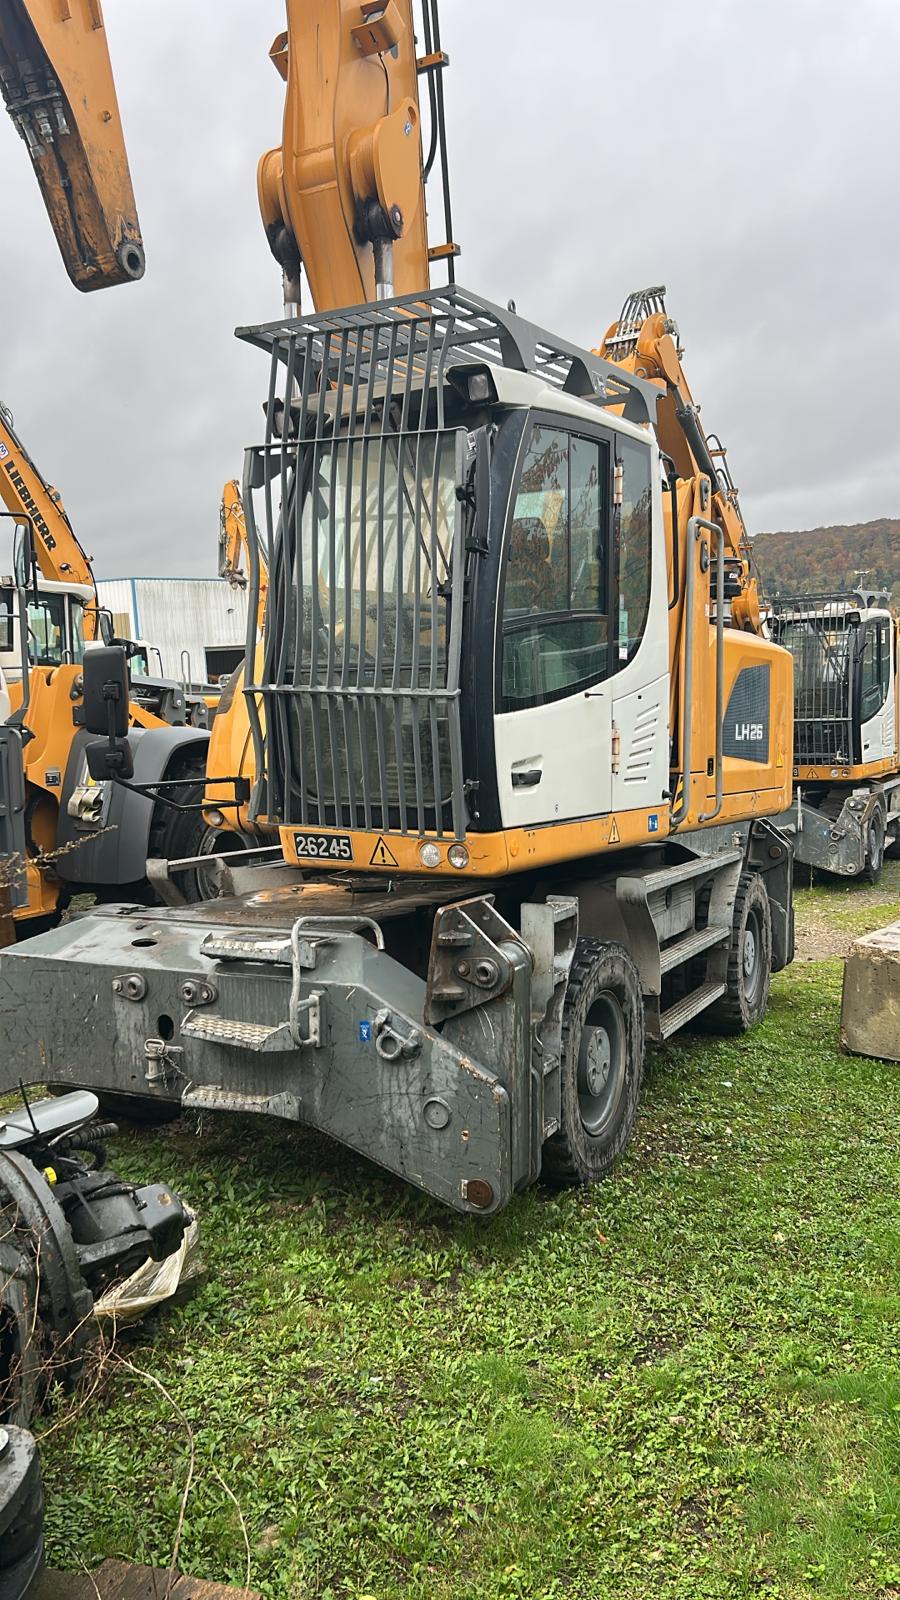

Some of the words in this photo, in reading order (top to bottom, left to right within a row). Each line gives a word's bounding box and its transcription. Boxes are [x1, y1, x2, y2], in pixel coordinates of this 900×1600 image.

[4, 460, 57, 552] LIEBHERR
[735, 723, 763, 741] LH26
[296, 836, 351, 858] 26245
